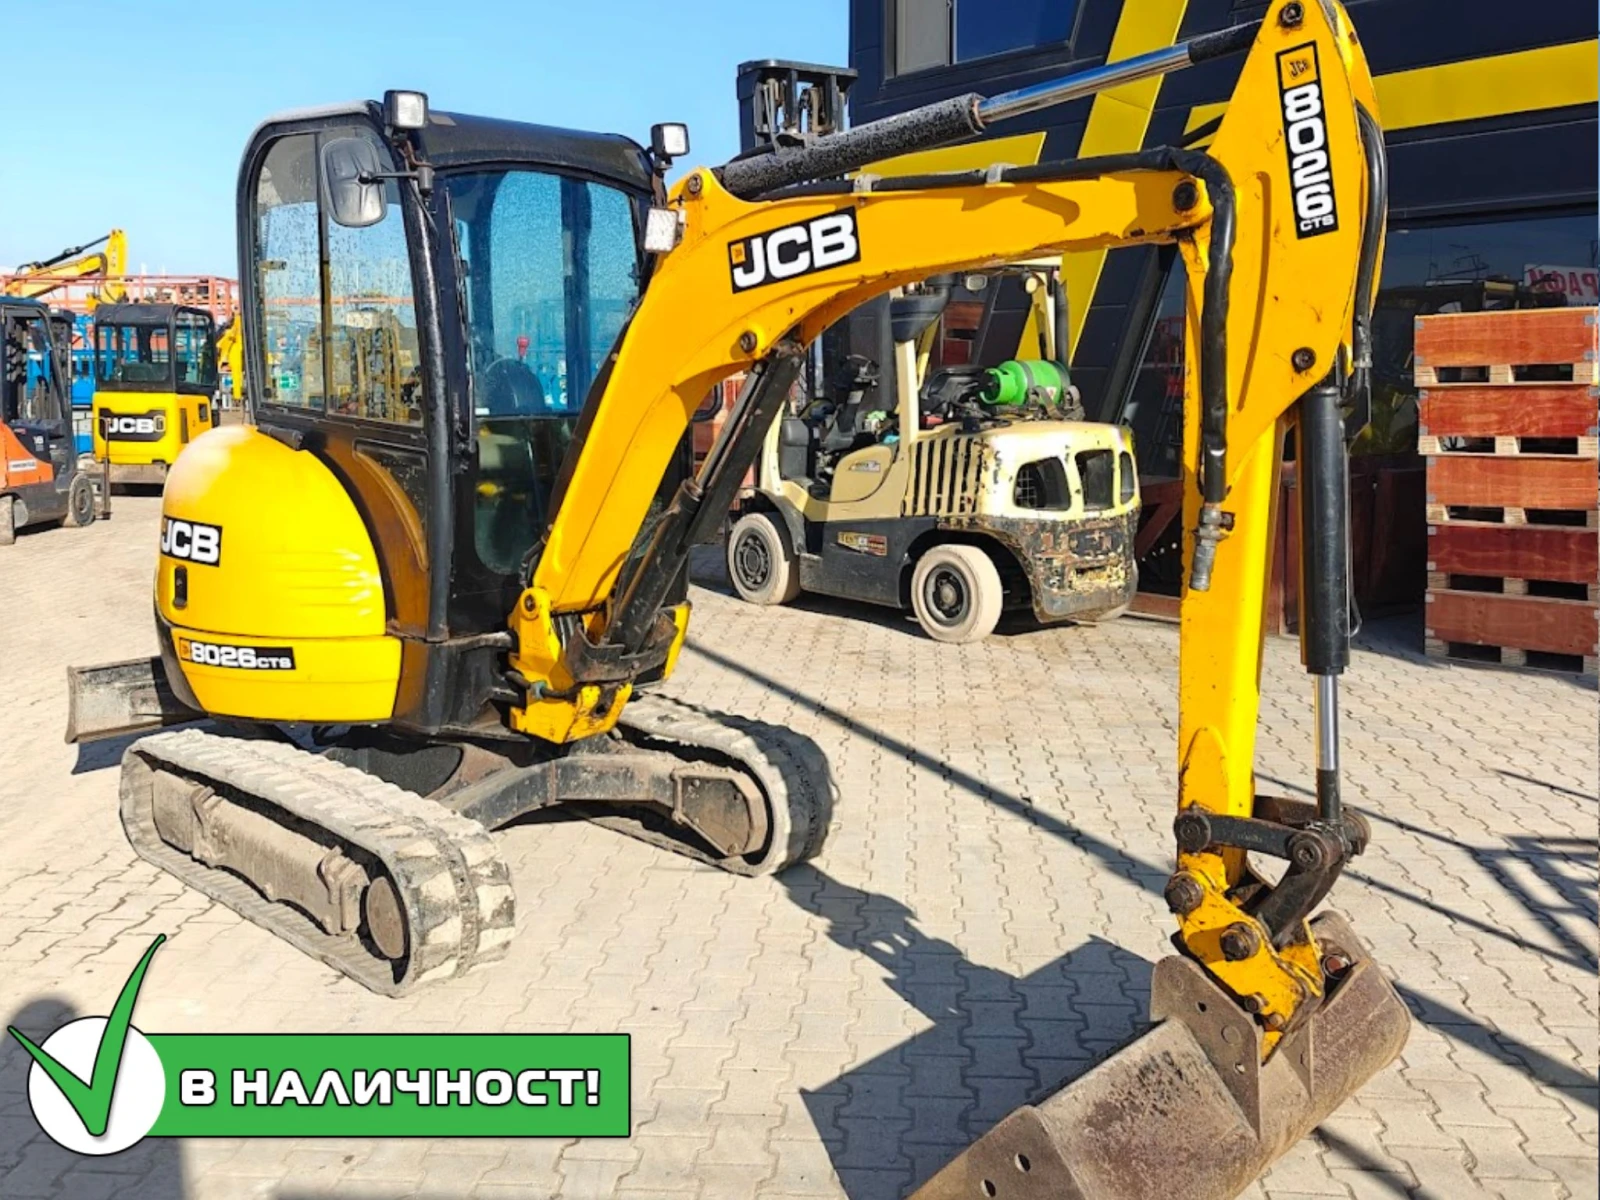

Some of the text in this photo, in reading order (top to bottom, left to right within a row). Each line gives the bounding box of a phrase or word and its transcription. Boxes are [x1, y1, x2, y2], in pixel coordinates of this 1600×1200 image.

[1283, 83, 1334, 219] 8026
[1300, 214, 1336, 232] CTS
[732, 213, 858, 288] JCB
[107, 418, 154, 433] JCB
[161, 519, 219, 563] JCB
